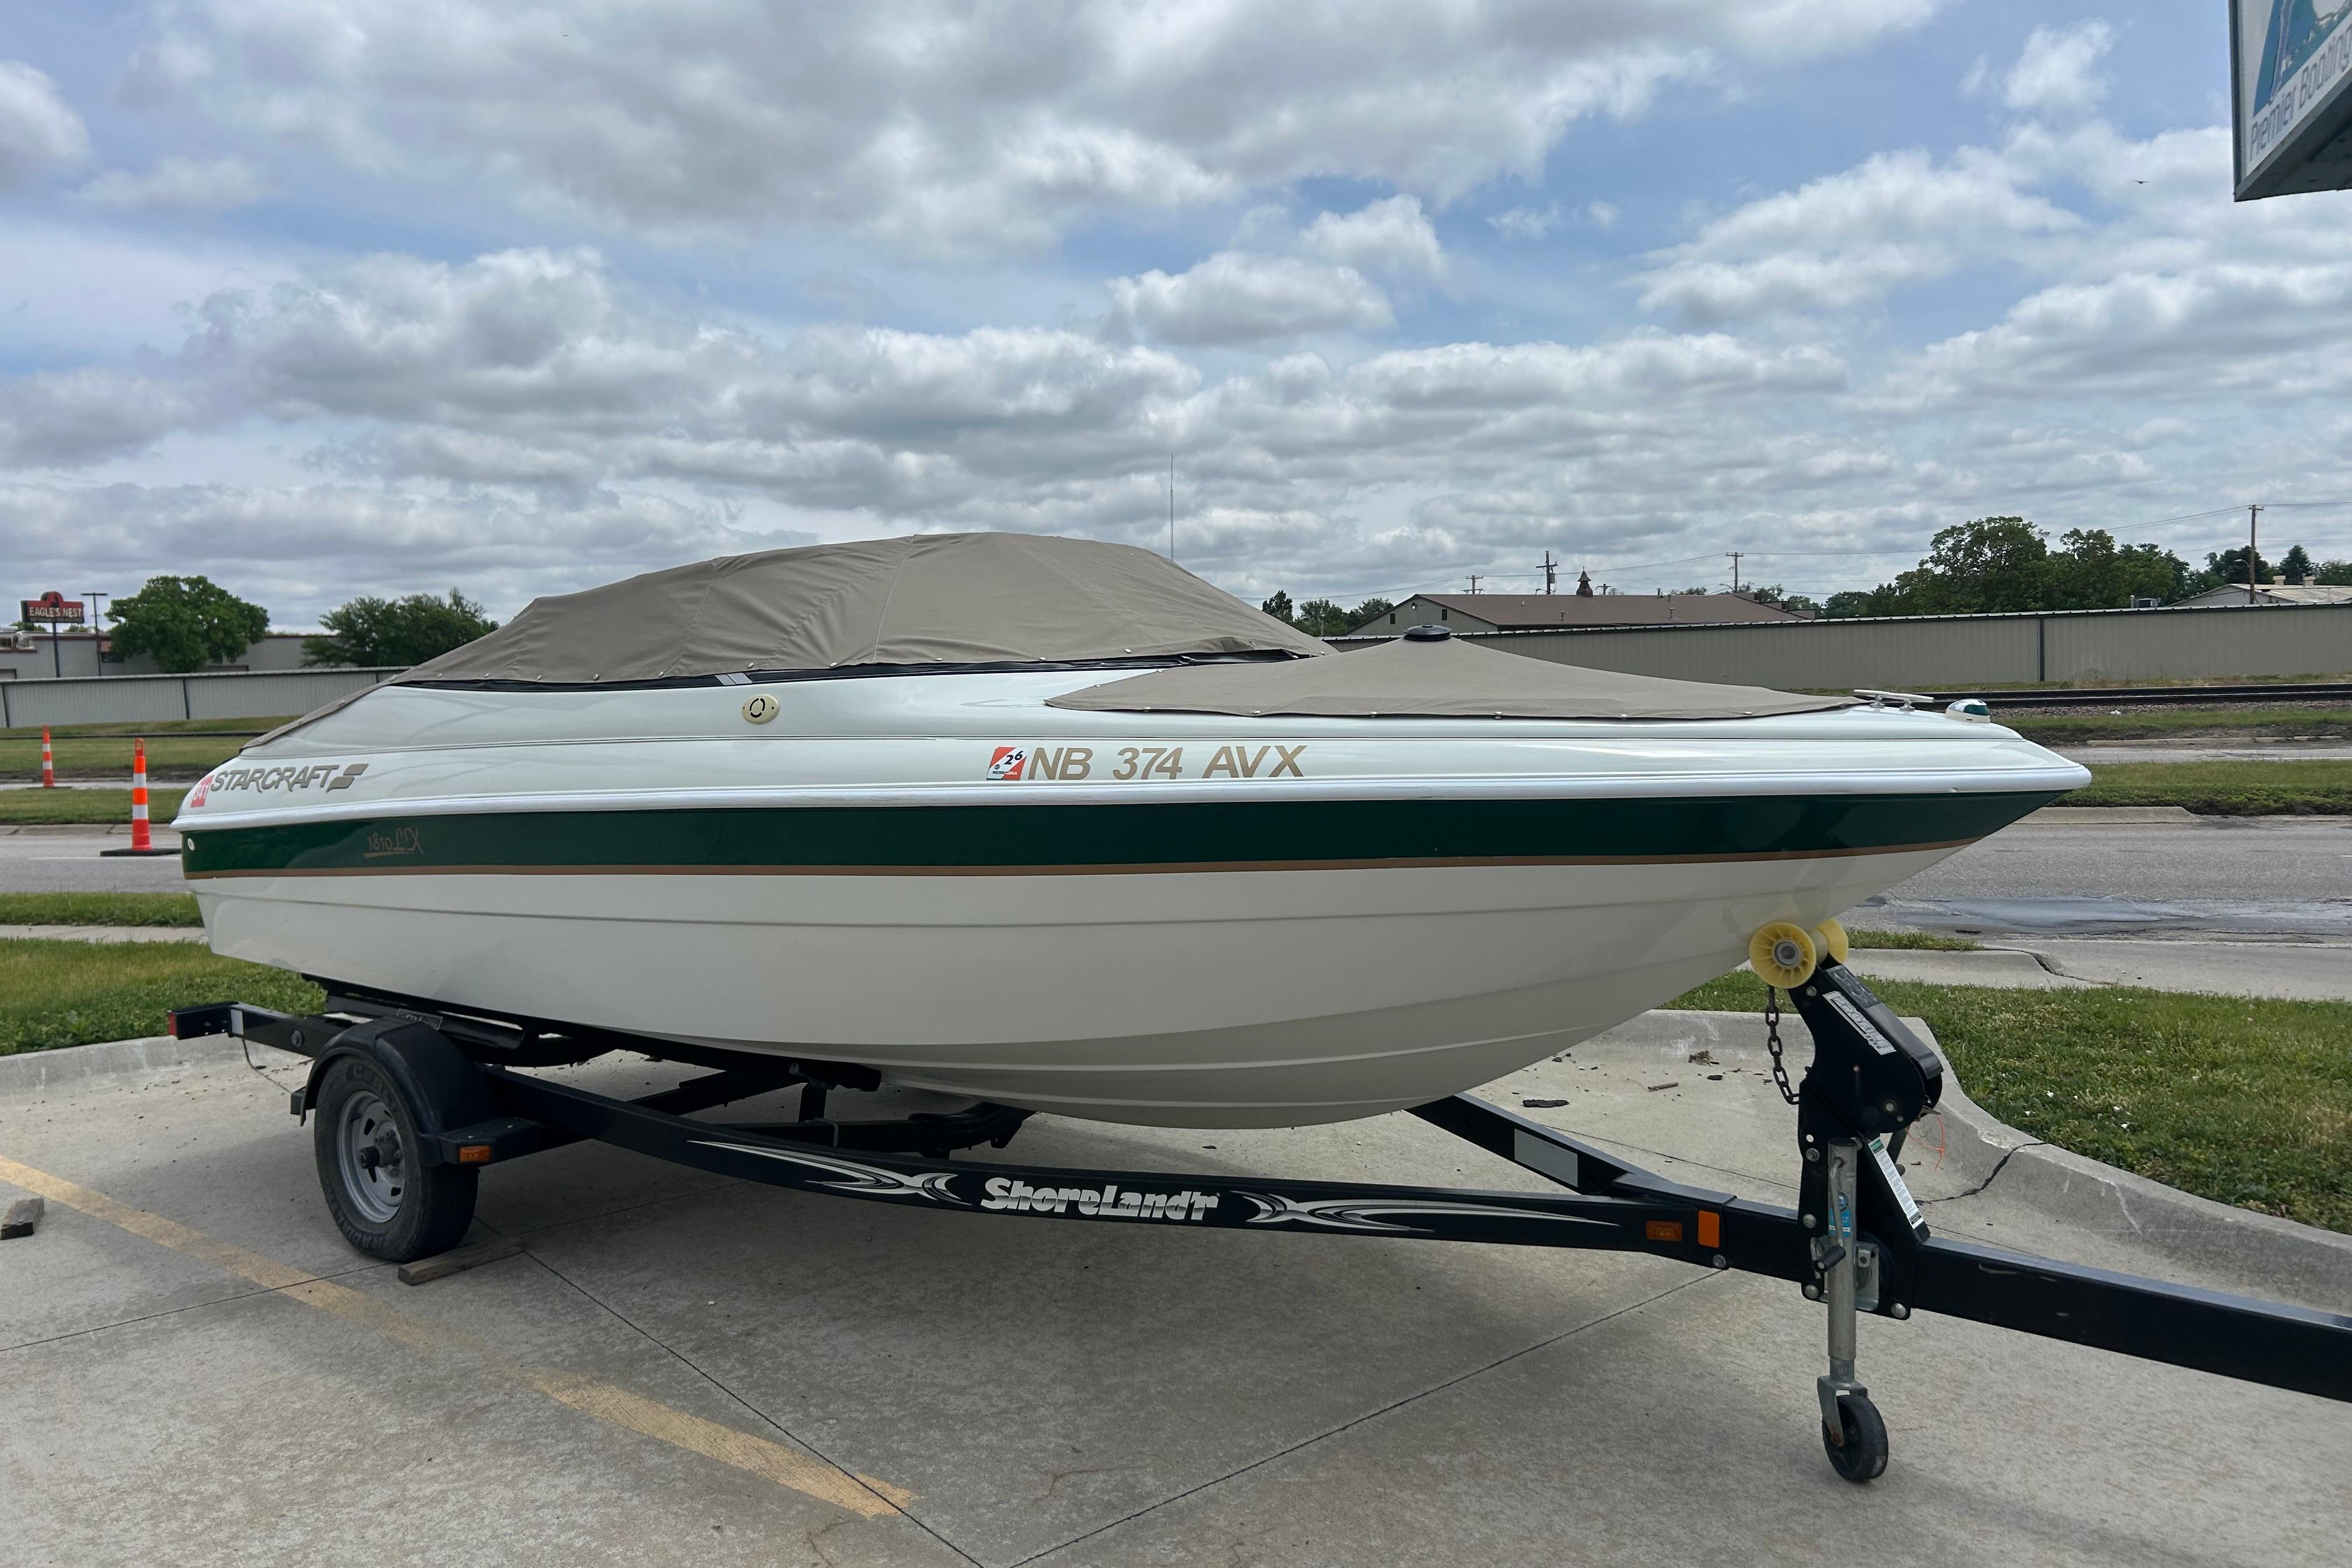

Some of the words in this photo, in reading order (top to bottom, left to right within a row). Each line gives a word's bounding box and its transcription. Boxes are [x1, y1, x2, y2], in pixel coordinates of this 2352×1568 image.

[29, 607, 61, 617] EAGLE'S
[62, 607, 82, 617] NEST
[1004, 750, 1024, 765] 26
[1028, 747, 1093, 780] NB
[1112, 747, 1183, 780] 374
[1202, 745, 1307, 778] AVX
[211, 764, 340, 793] STARCRAFT
[367, 831, 393, 852] 1810
[393, 827, 425, 855] LX
